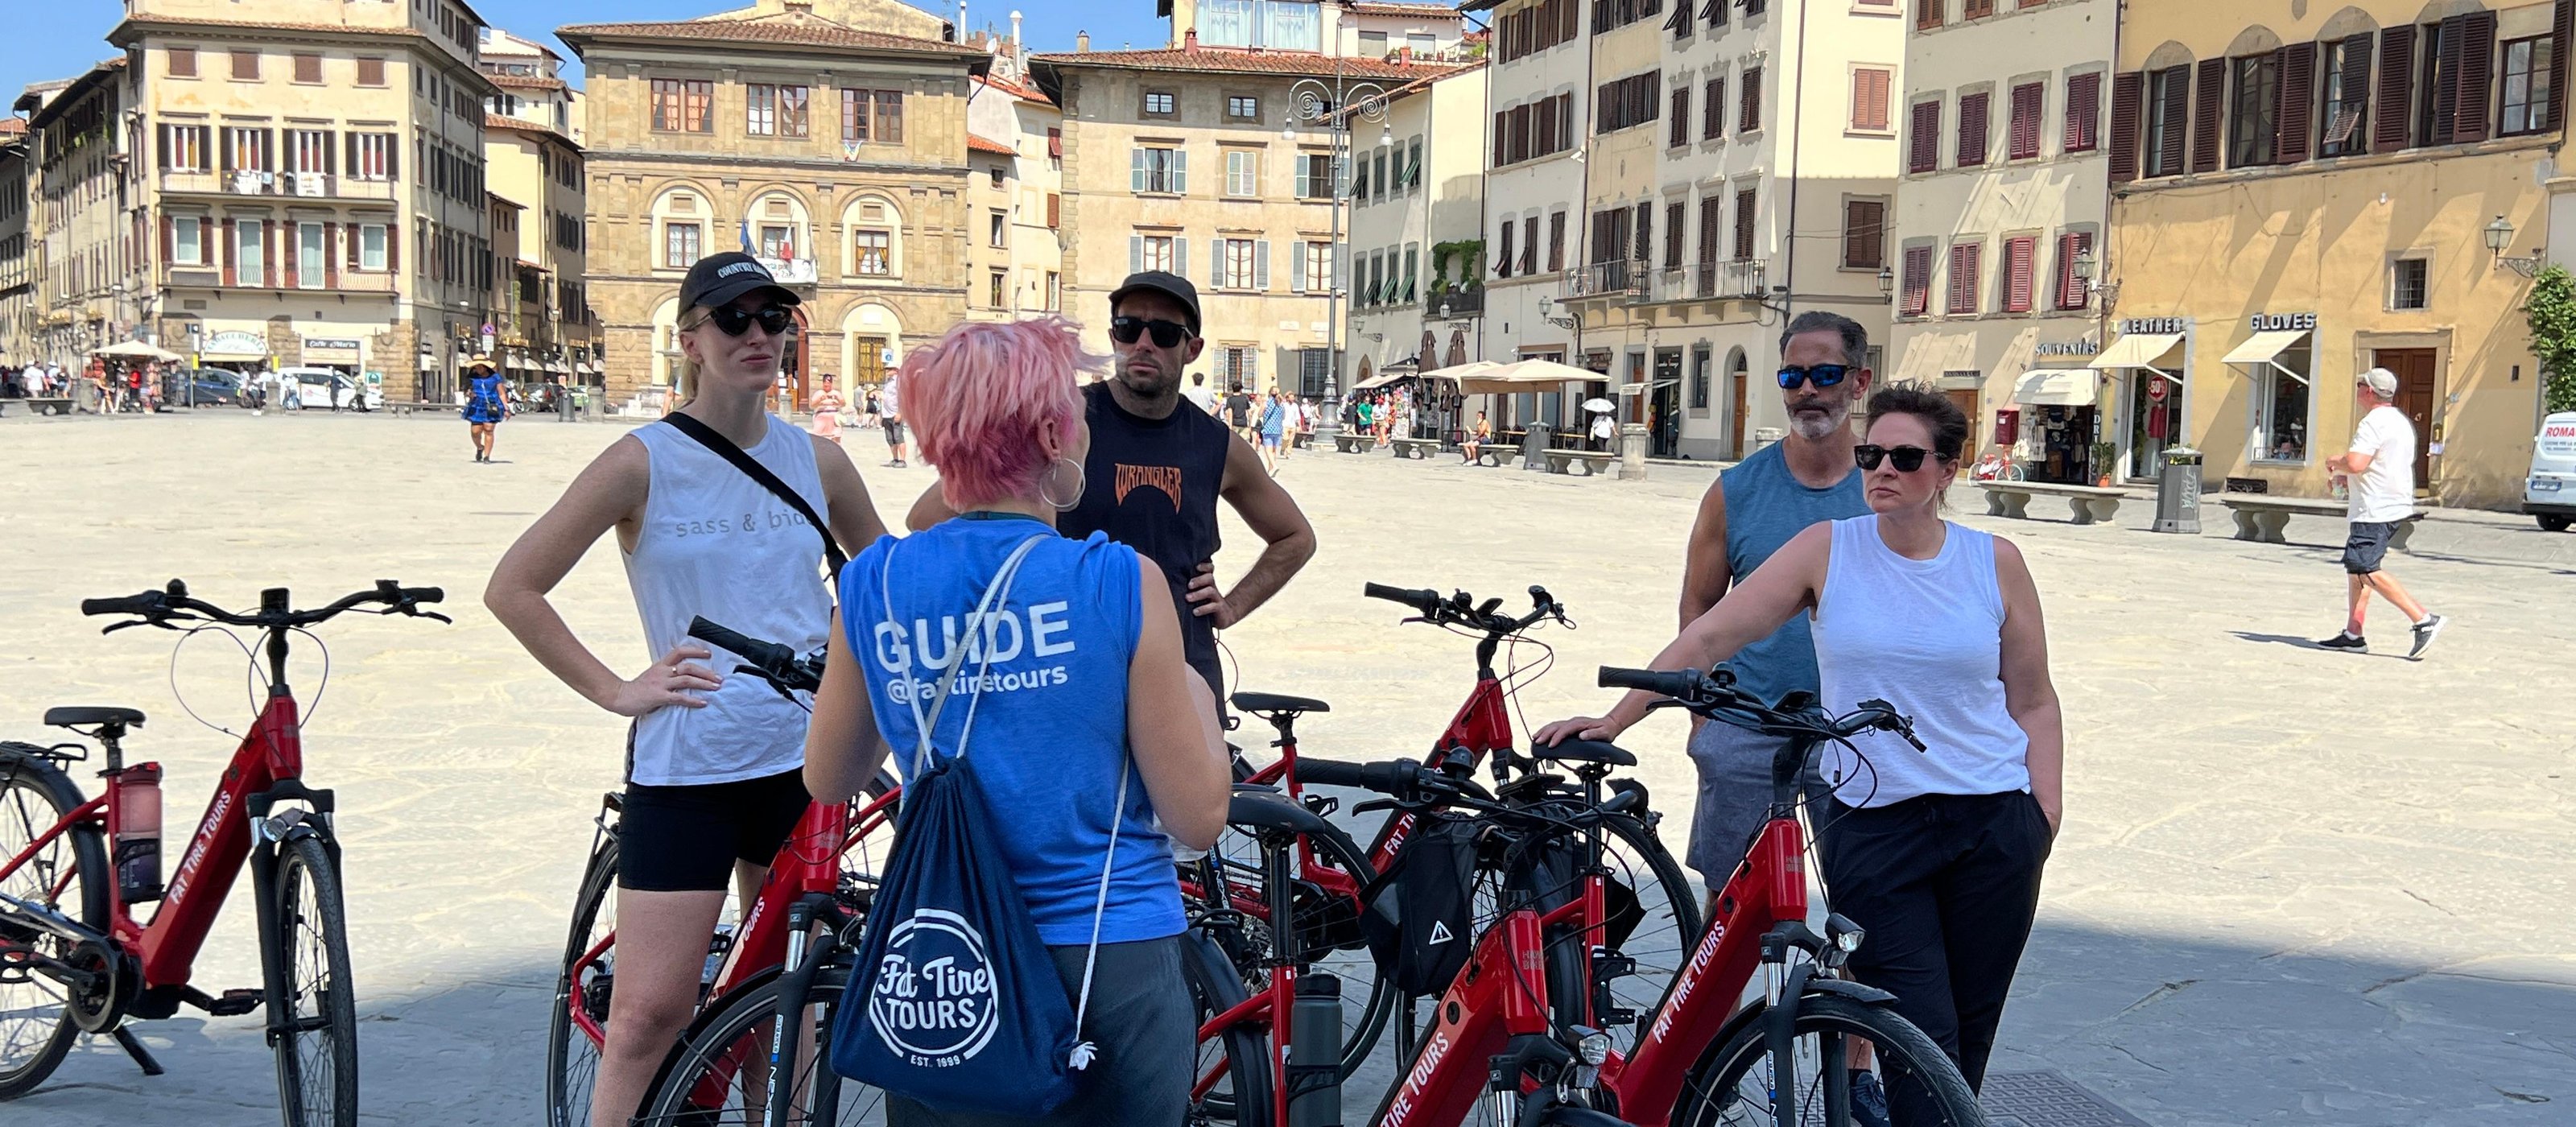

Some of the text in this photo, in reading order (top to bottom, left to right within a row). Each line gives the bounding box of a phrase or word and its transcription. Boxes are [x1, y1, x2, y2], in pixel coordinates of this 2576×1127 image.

[2124, 317, 2182, 334] LEATHER
[2250, 312, 2317, 331] GLOVES
[2035, 343, 2098, 356] SOUVENIRS
[1114, 463, 1182, 515] WRANGLER
[675, 509, 812, 538] sass & bid
[874, 601, 1076, 674] GUIDE
[168, 790, 232, 905] FAT TIRE TOURS
[1383, 812, 1417, 857] FAT TI
[743, 896, 766, 942] OURS
[922, 956, 991, 998] Tire
[1652, 920, 1726, 1045] FAT TIRE TOURS
[886, 997, 977, 1030] TOURS
[1380, 1031, 1449, 1127] TIRE TOURS
